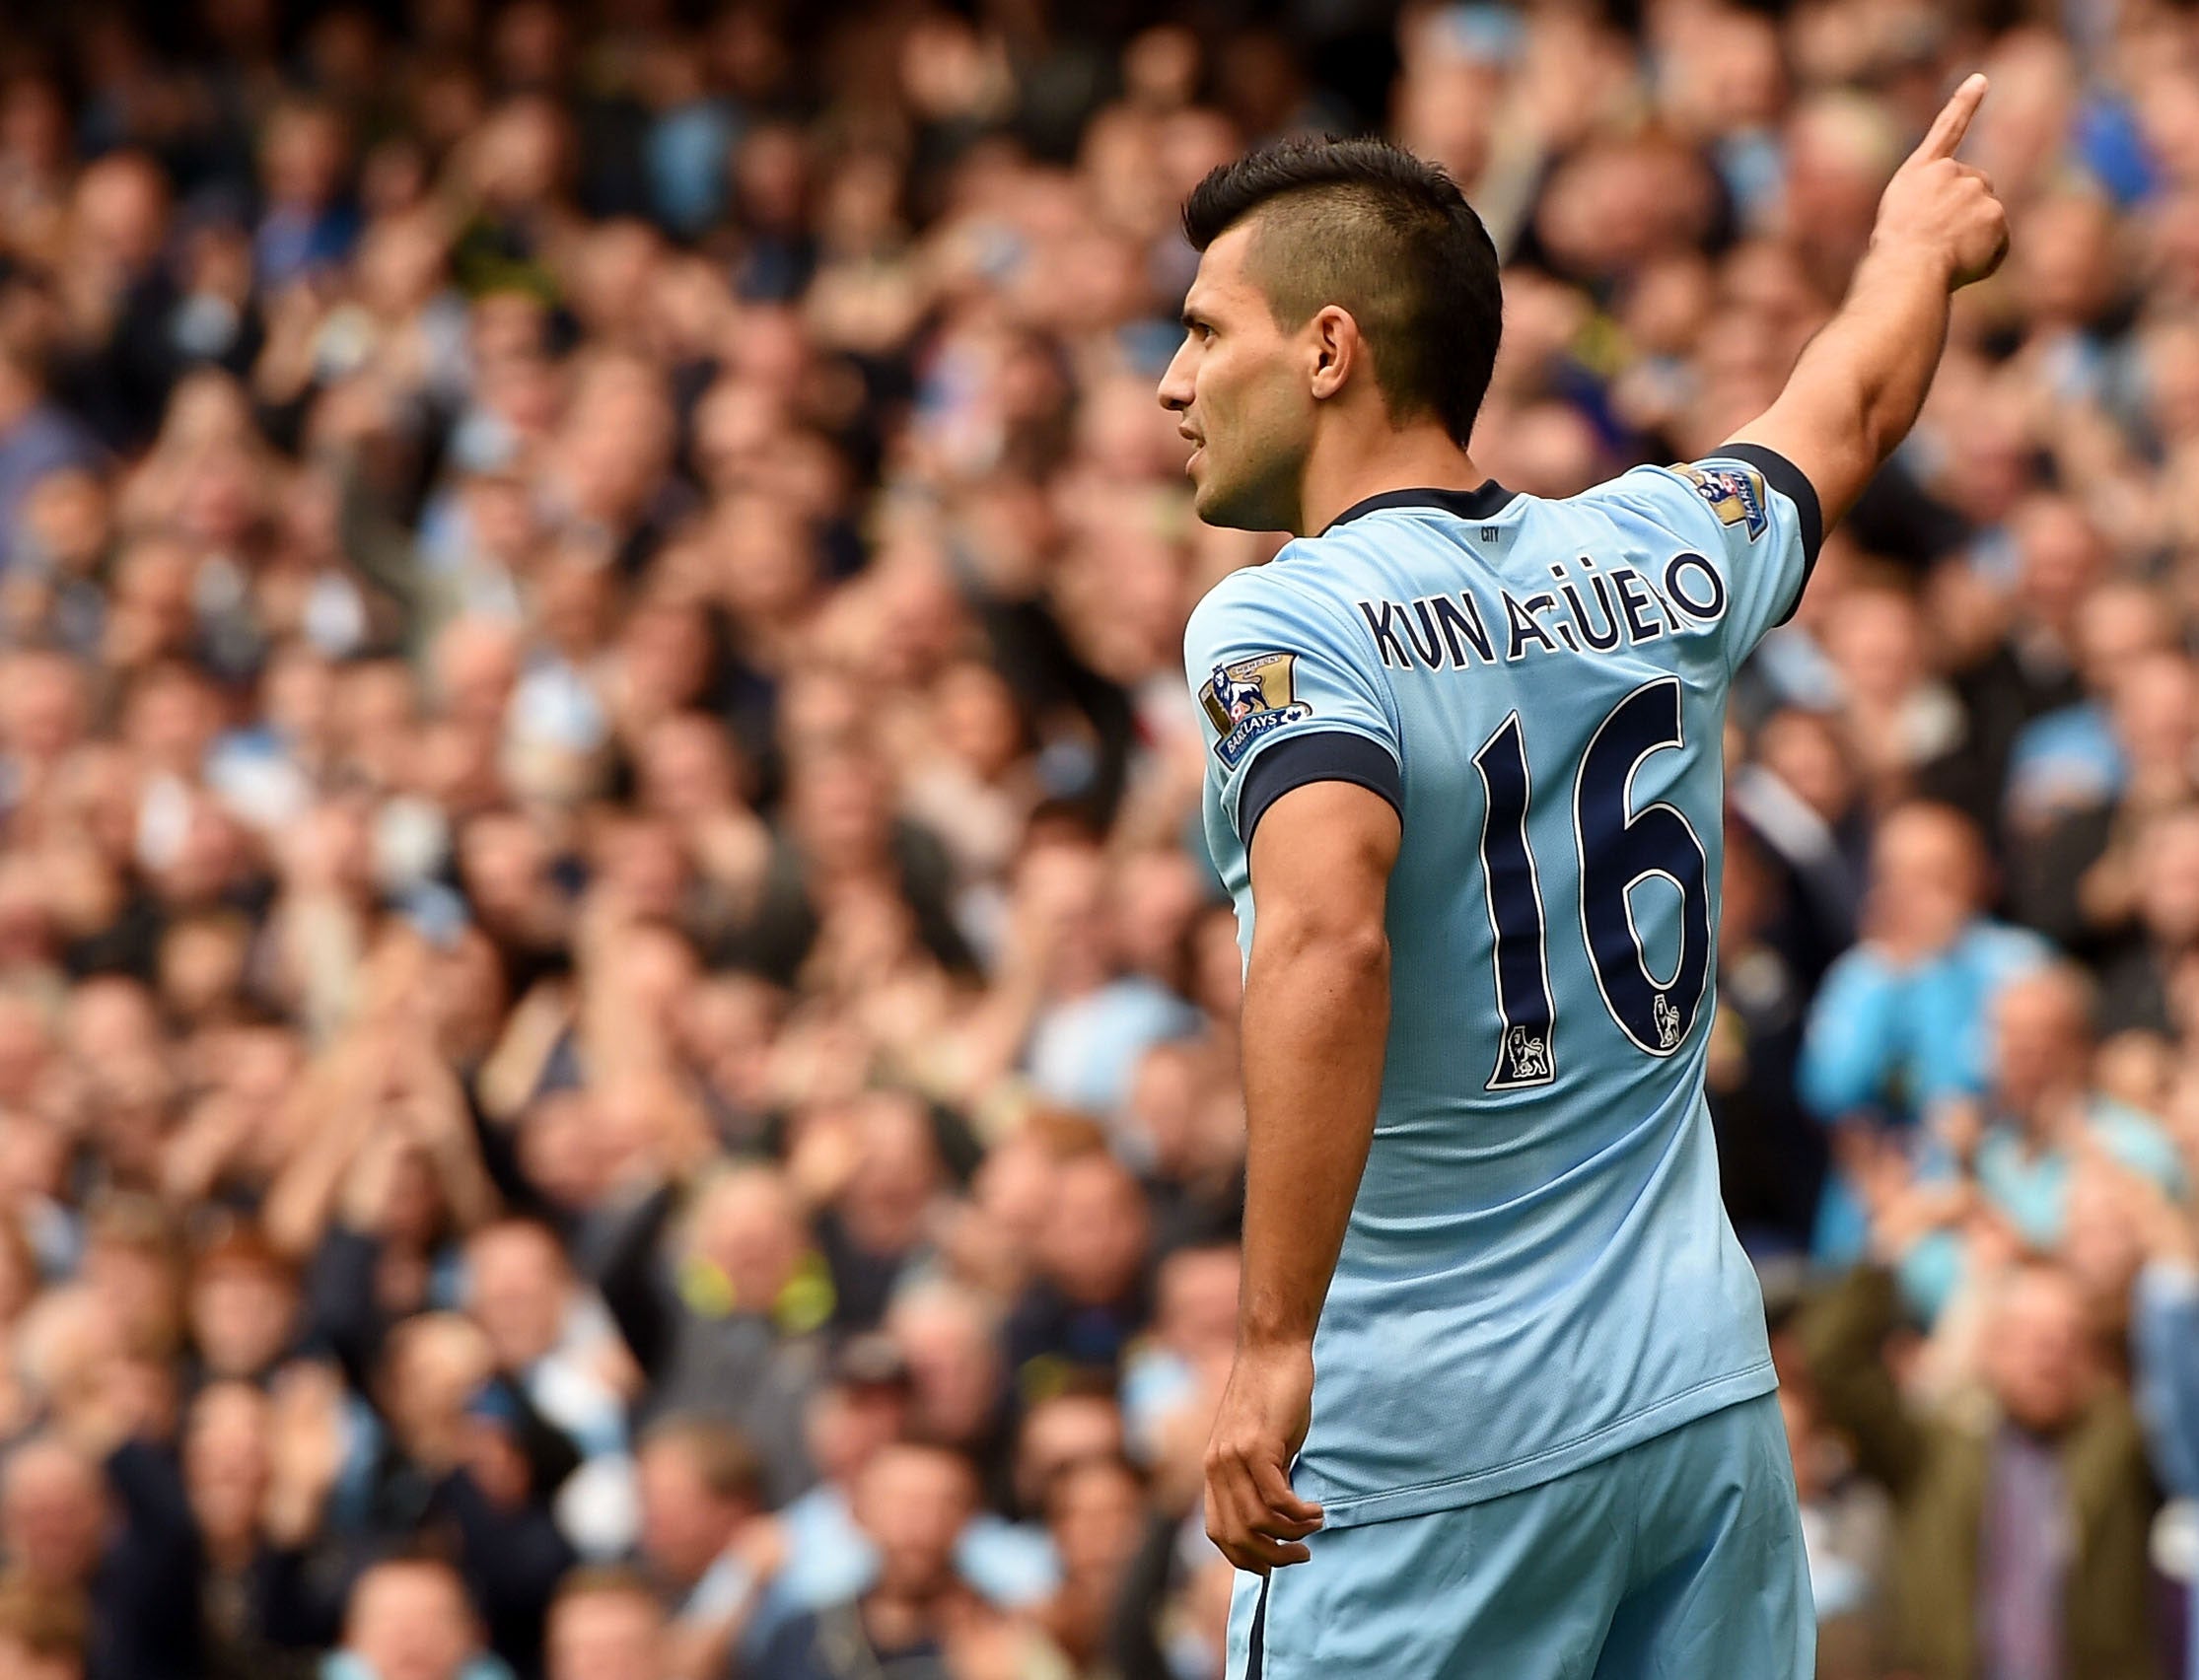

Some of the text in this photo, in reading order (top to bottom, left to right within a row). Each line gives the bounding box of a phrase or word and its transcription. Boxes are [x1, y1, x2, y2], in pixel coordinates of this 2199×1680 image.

[1481, 525, 1499, 542] CITY
[1357, 591, 1498, 671] KUN
[1226, 713, 1278, 754] BARCLAYS
[1471, 675, 1712, 1090] 16
